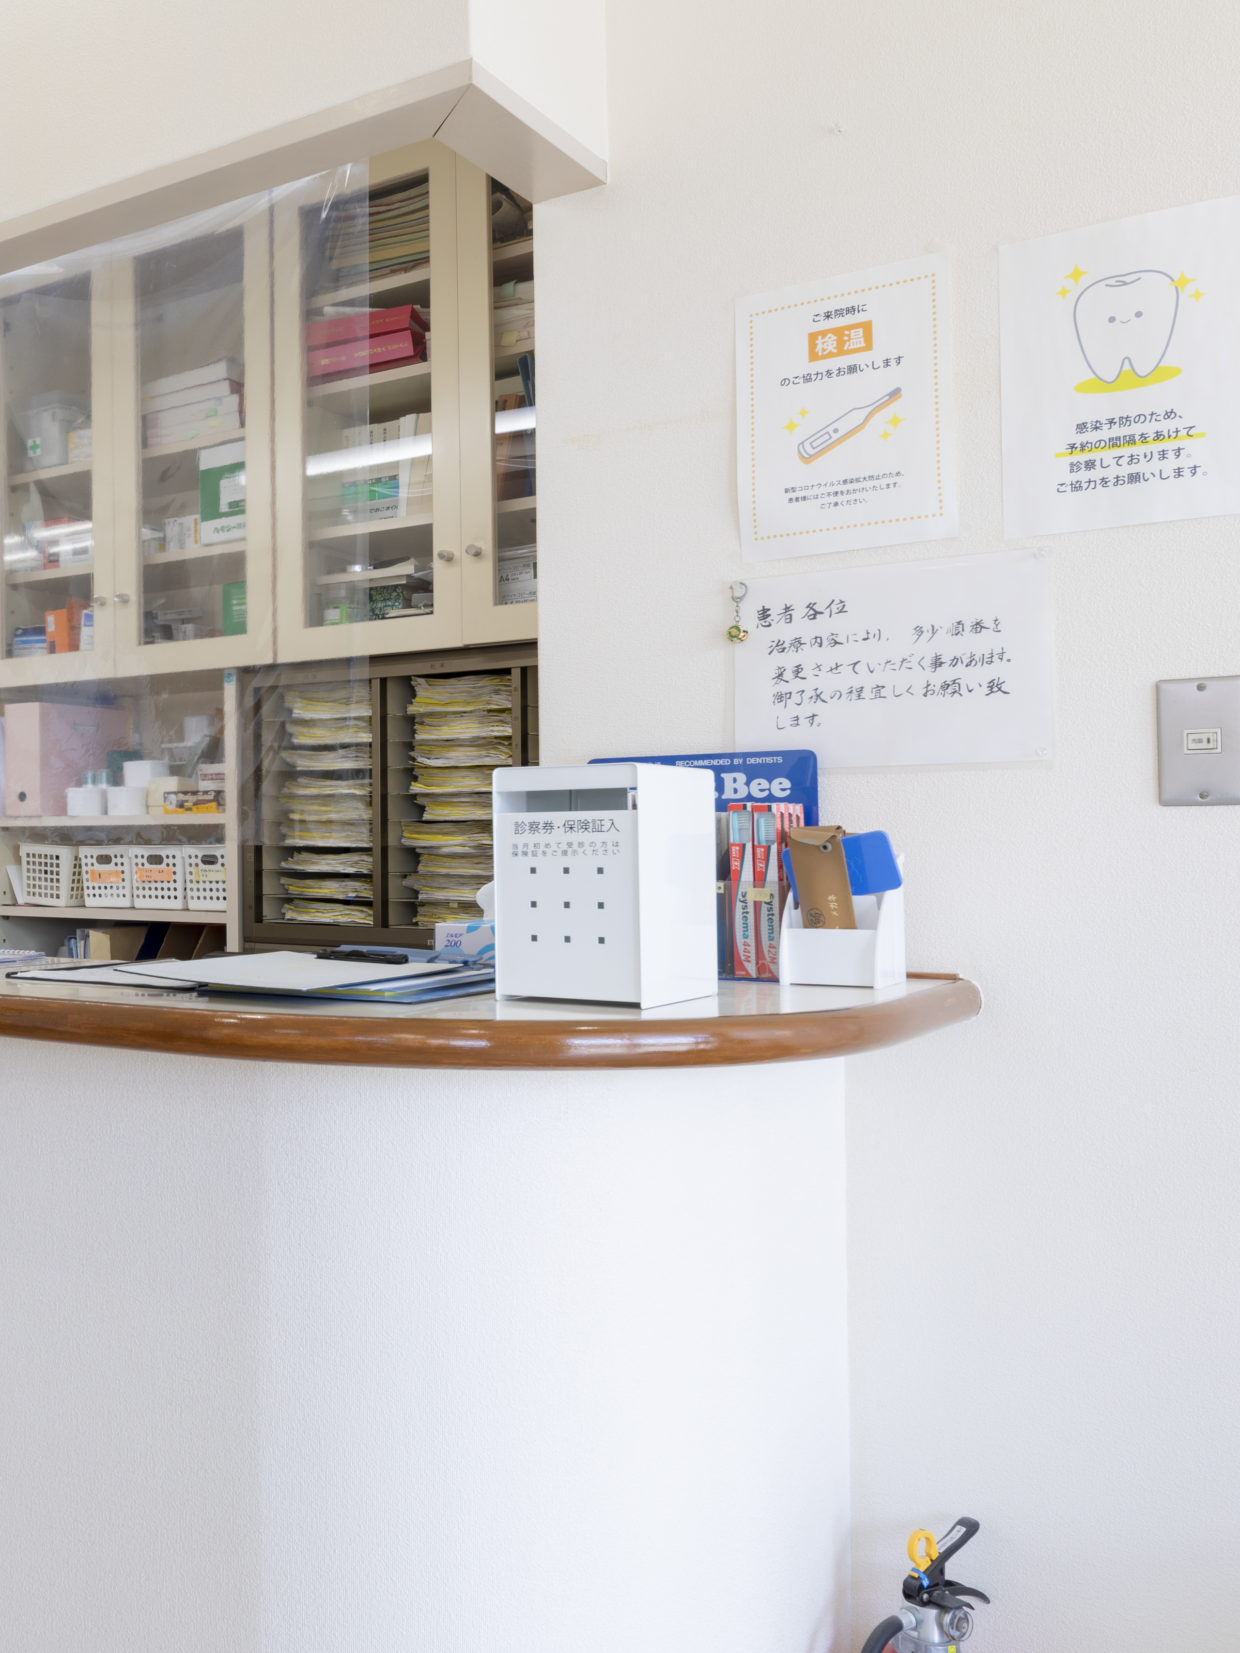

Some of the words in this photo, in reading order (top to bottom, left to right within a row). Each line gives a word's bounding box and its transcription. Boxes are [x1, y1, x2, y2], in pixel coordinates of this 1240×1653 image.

[811, 303, 868, 323] ご来院時に
[815, 327, 866, 356] 検温
[779, 355, 905, 388] のご協力をお願いします
[1075, 408, 1184, 434] 感染予防のため、
[1064, 425, 1196, 455] 予約の間隔をあけて
[1069, 446, 1192, 474] 診察しております。
[1056, 464, 1209, 494] ご協力をお願いします。
[756, 599, 849, 629] 患者各位
[771, 647, 1012, 686] 変更させていただく事があります。
[772, 676, 1010, 709] 御了承の程宜しくお願い致
[776, 713, 822, 730] します。
[676, 757, 731, 767] RECOMMENDED
[733, 757, 743, 765] BY
[746, 756, 783, 764] DENTISTS
[513, 819, 621, 835] 診察券・保険証入
[444, 939, 463, 949] 200
[742, 940, 752, 964] 44M
[767, 942, 777, 965] 42M
